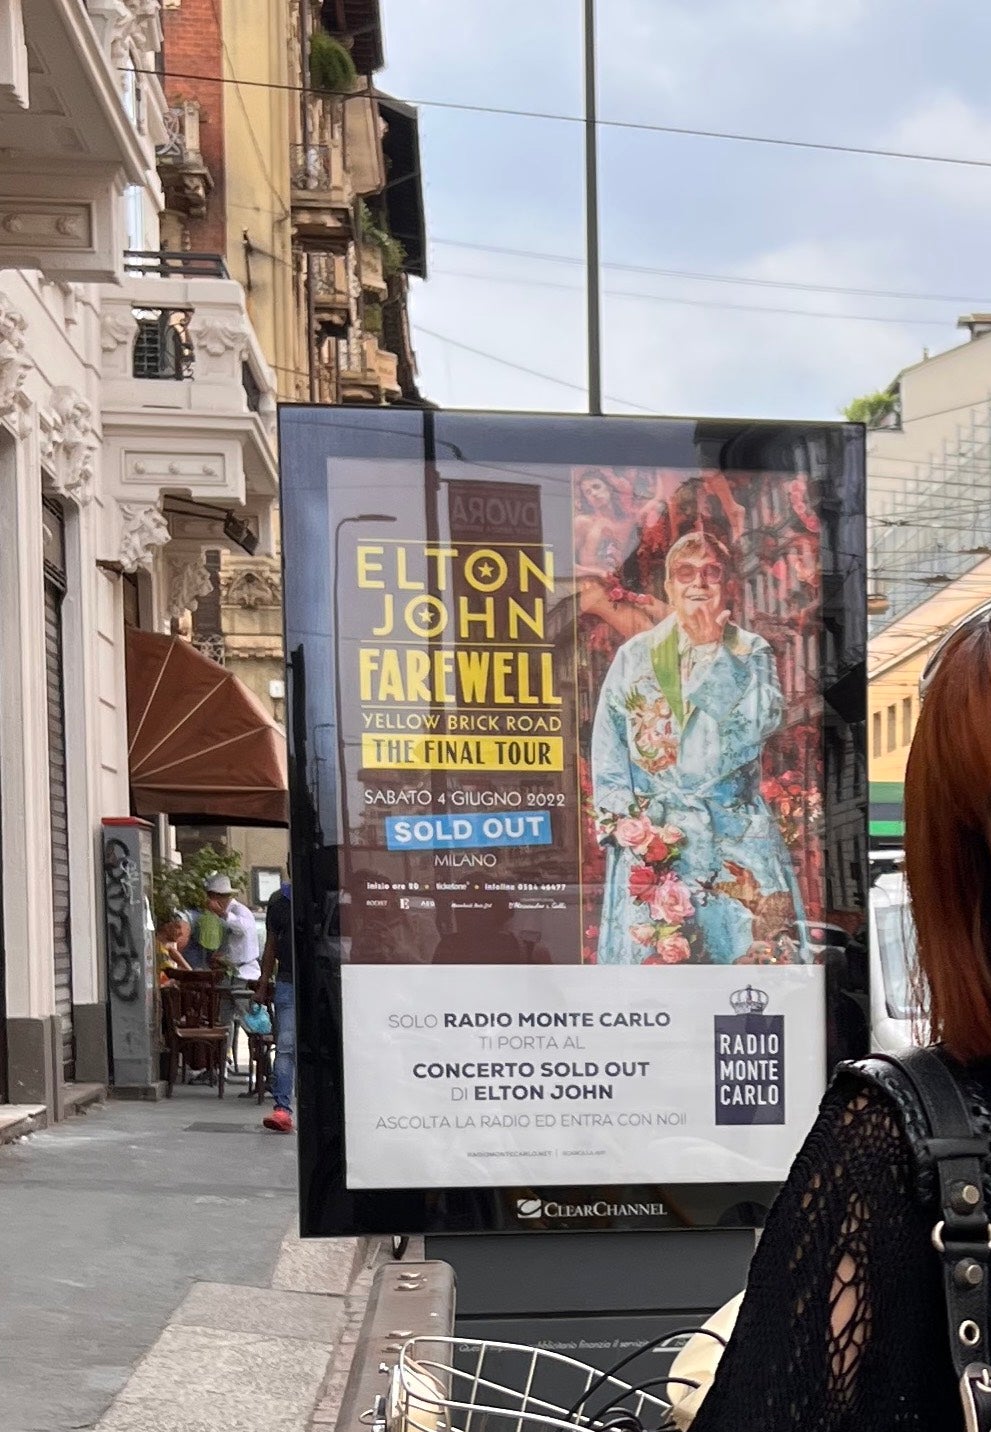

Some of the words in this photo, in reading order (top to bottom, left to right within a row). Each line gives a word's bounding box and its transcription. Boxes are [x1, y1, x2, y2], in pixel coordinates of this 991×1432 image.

[357, 545, 555, 592] ELTON
[373, 594, 545, 640] JOHN
[359, 649, 562, 705] FAREWELL
[362, 712, 441, 731] YELLOW
[447, 714, 502, 731] BRICK
[506, 715, 562, 732] ROAD
[374, 738, 415, 763] THE
[424, 740, 486, 765] FINAL
[494, 741, 552, 766] TOUR
[364, 789, 432, 807] SABATO
[437, 794, 446, 807] 4
[451, 790, 522, 808] GIUGNO
[527, 792, 566, 808] 2022
[394, 817, 473, 844] SOLD
[482, 813, 545, 840] OUT
[434, 853, 497, 868] MILANO
[388, 1013, 439, 1029] SOLO
[443, 1011, 513, 1028] RADIO
[518, 1011, 594, 1028] MONTE
[599, 1011, 671, 1027] CARLO
[479, 1036, 494, 1050] TI
[498, 1035, 559, 1050] PORTA
[563, 1035, 586, 1050] AL
[720, 1033, 778, 1055] RADIO
[413, 1062, 535, 1079] CONCERTO
[541, 1061, 600, 1078] SOLD
[604, 1061, 650, 1077] OUT
[720, 1059, 779, 1081] MONTE
[451, 1086, 469, 1101] DI
[474, 1083, 545, 1101] ELTON
[549, 1083, 614, 1100] JOHN
[720, 1083, 779, 1106] CARLO
[376, 1115, 450, 1130] ASCOLTA
[456, 1115, 476, 1128] LA
[481, 1114, 530, 1128] RADIO
[536, 1114, 556, 1128] ED
[562, 1113, 612, 1127] ENTRA
[617, 1113, 652, 1127] CON
